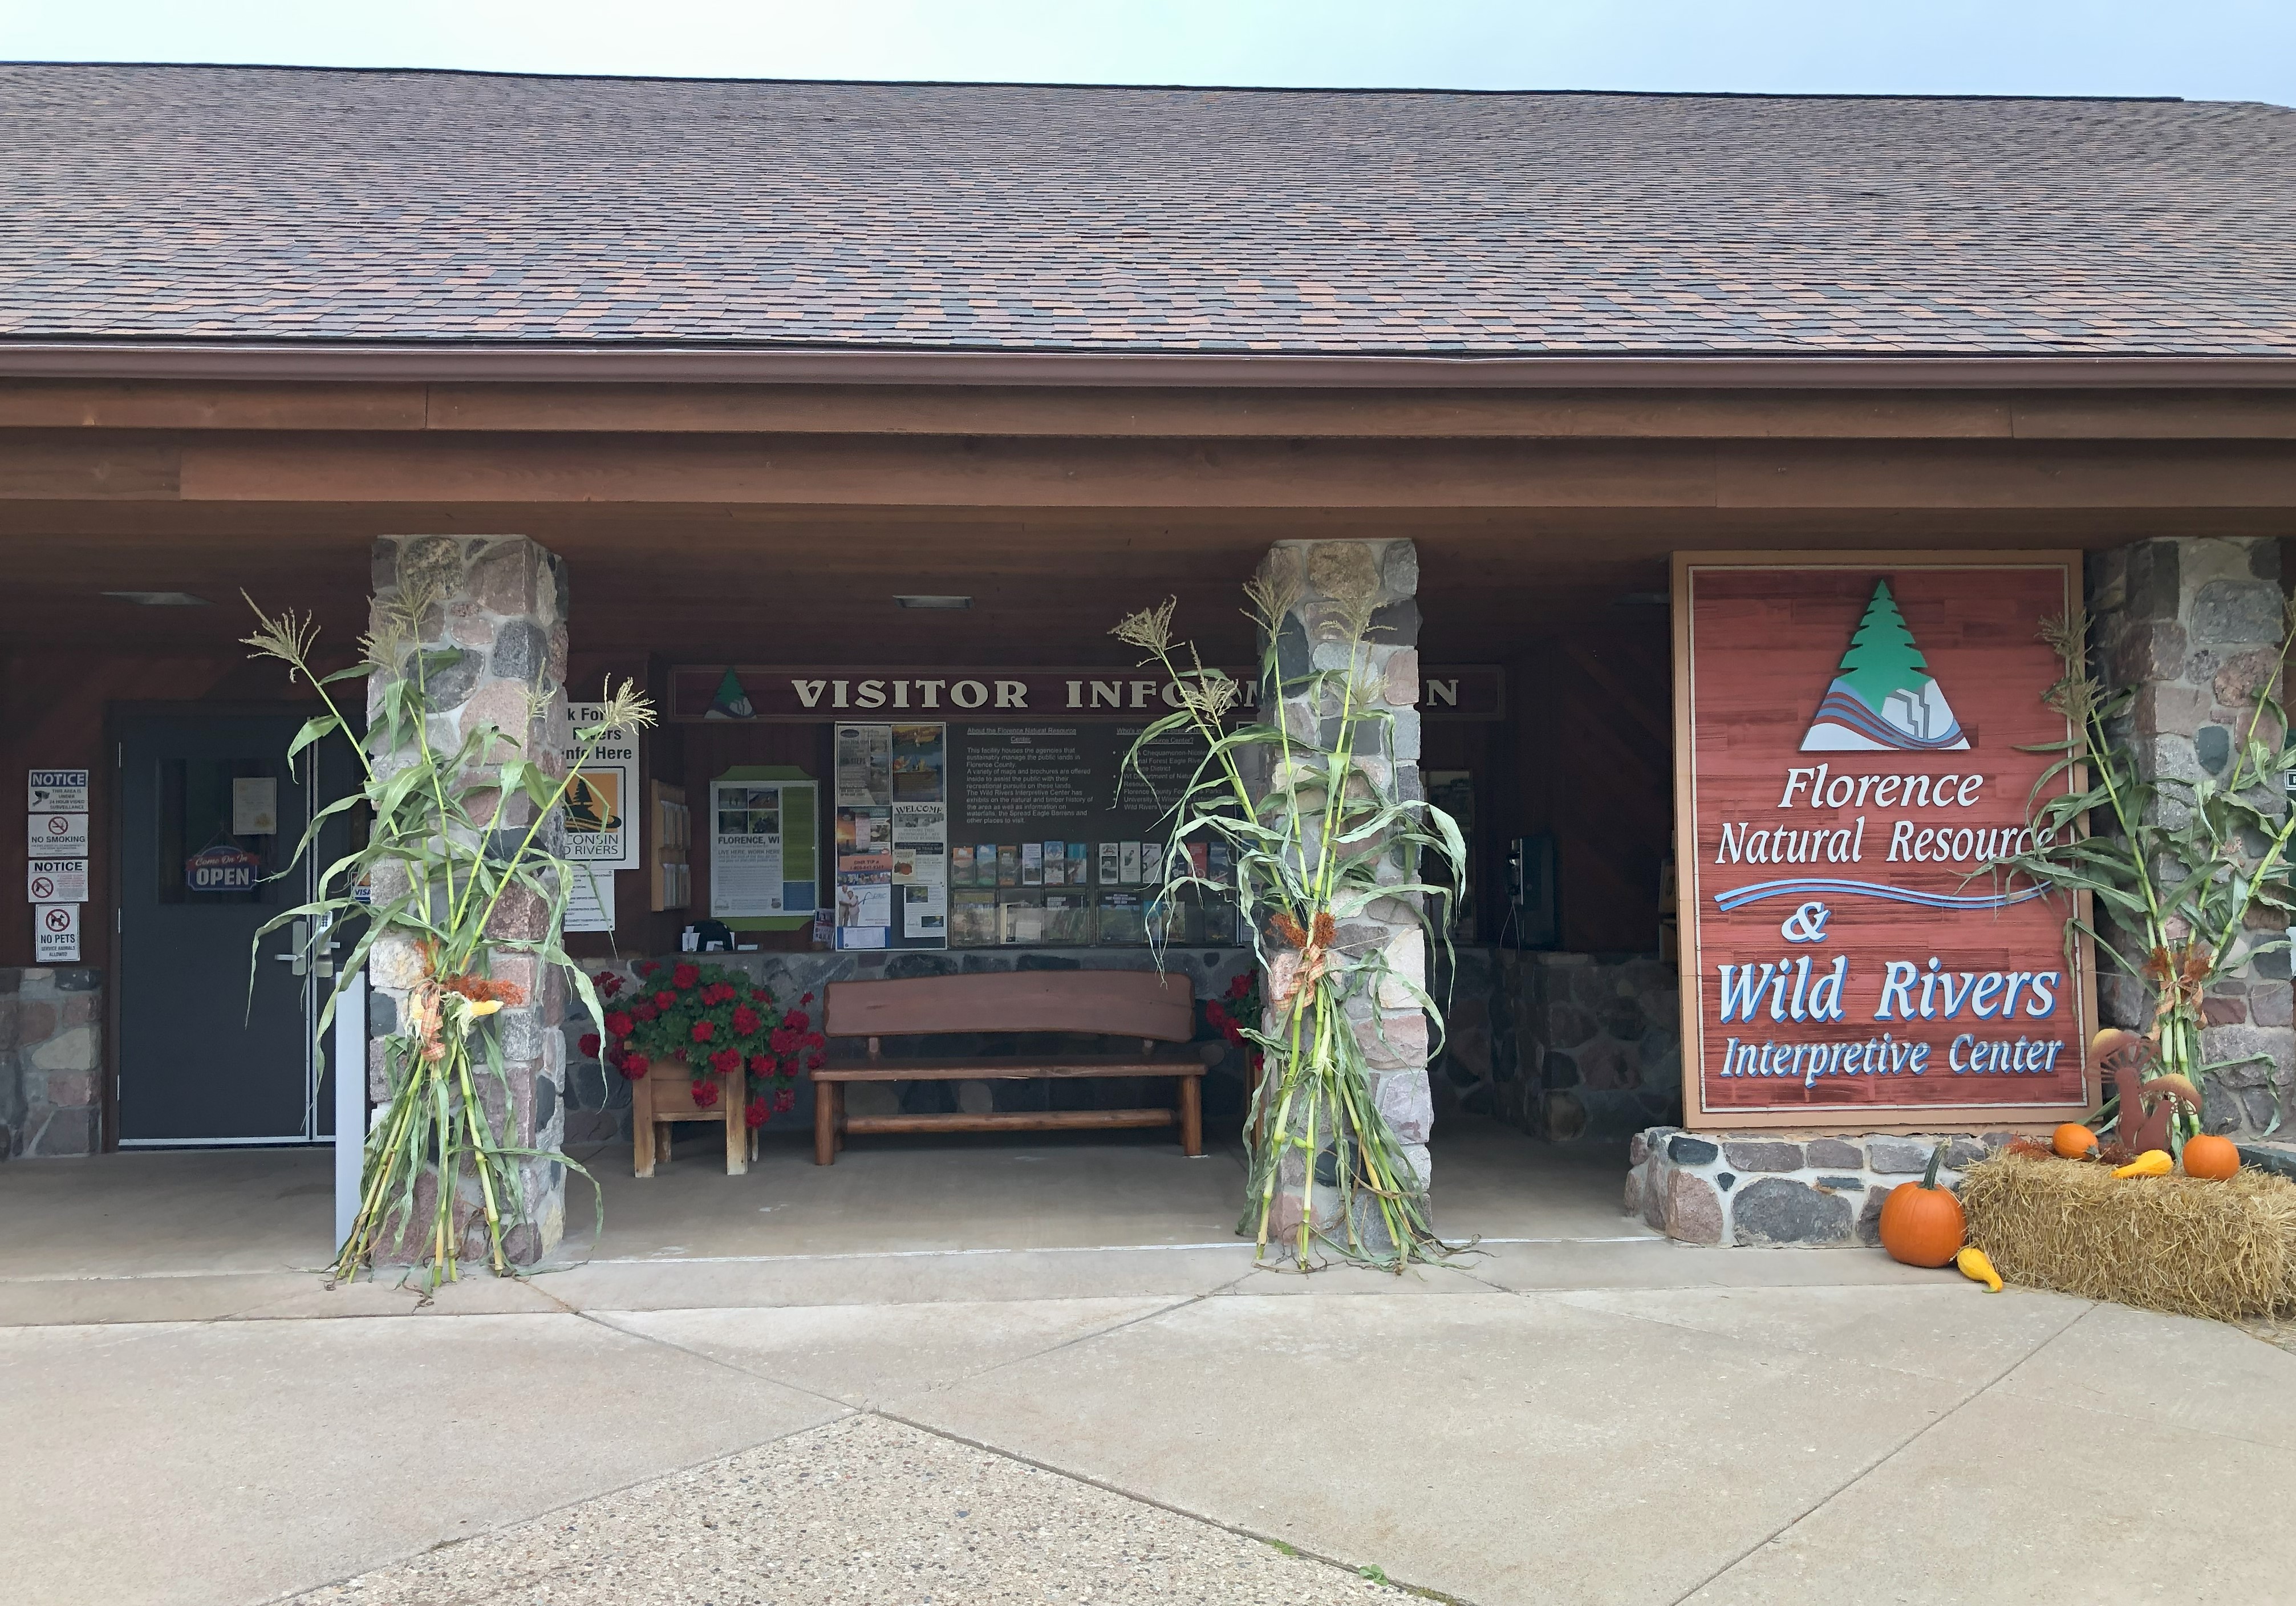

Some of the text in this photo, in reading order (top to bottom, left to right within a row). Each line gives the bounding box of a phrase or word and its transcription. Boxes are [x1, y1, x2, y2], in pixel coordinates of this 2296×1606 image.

[792, 679, 1028, 708] VISITOR
[595, 746, 632, 760] Here
[33, 773, 85, 786] NOTICE
[1777, 763, 1984, 809] Florence
[718, 836, 766, 845] FLORENCE,
[1714, 816, 1866, 865] Natural
[575, 845, 618, 855] RIVERS
[34, 862, 83, 871] NOTICE
[195, 857, 220, 867] Come
[221, 855, 234, 863] On
[196, 867, 249, 886] OPEN
[1780, 901, 1831, 943] &
[40, 934, 75, 944] NO PETS
[1716, 954, 2060, 1024] Wild Rivers
[1720, 1032, 2065, 1089] Interpretive Center
